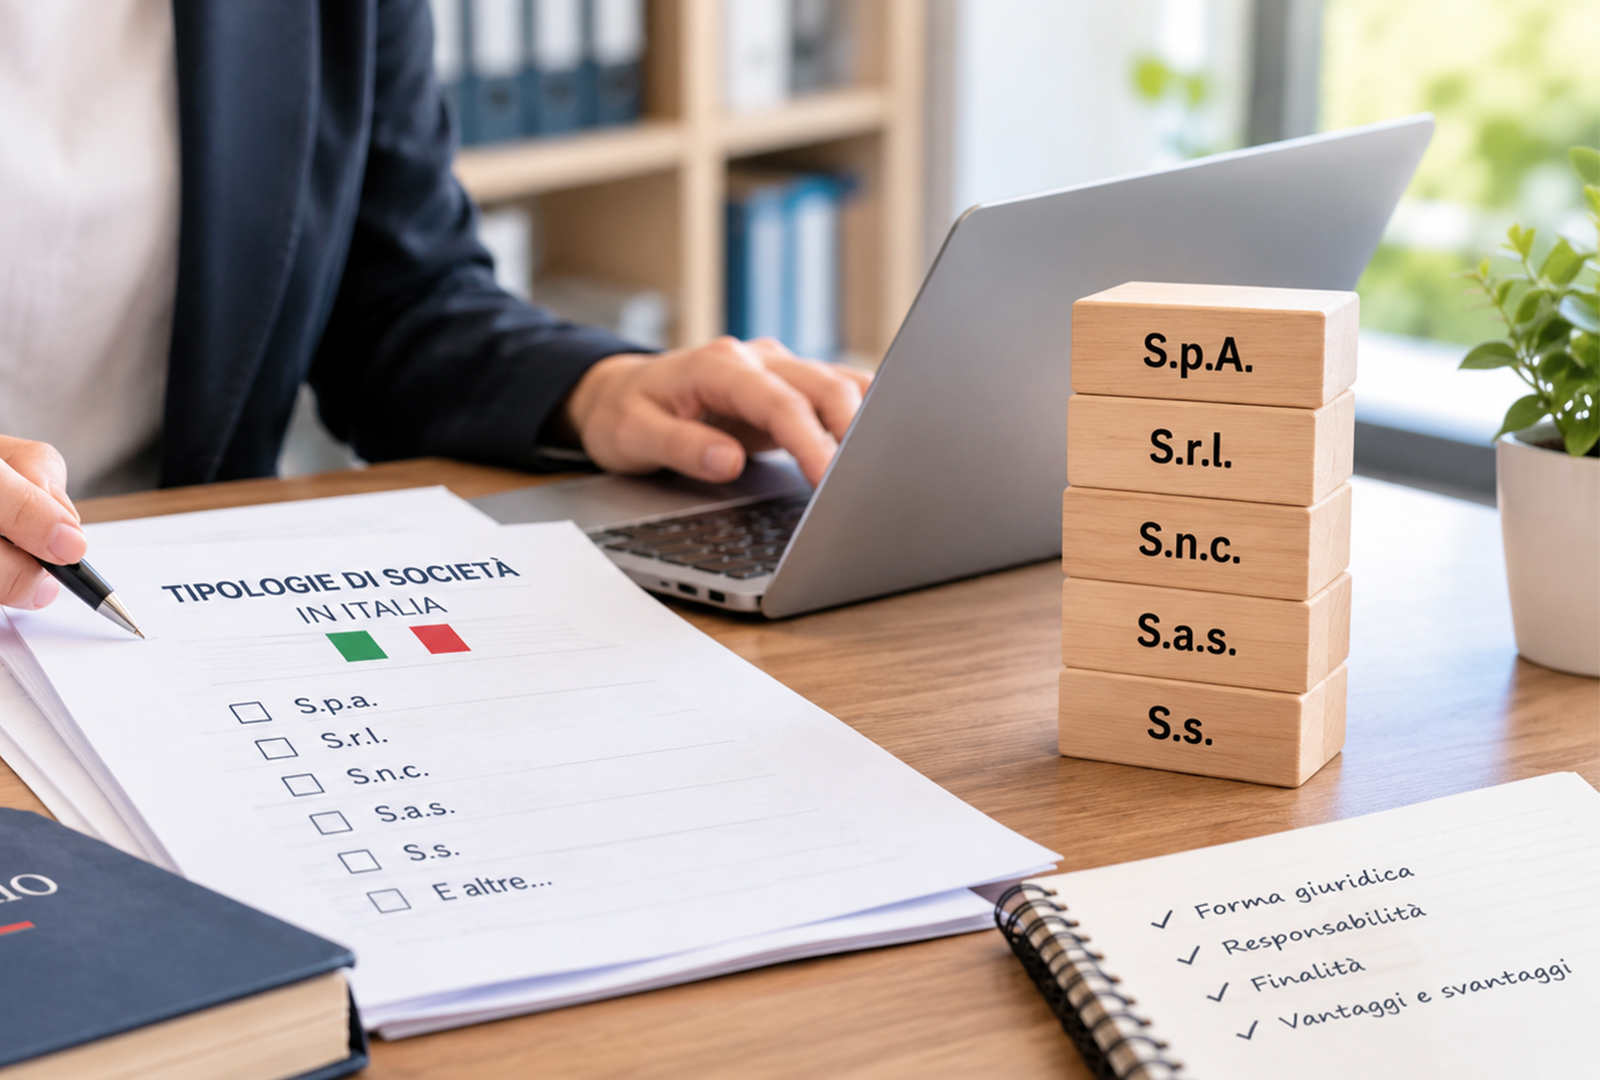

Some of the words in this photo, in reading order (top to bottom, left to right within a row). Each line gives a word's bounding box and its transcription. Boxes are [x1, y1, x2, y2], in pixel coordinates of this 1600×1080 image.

[1143, 332, 1253, 379] S.p.A.
[1149, 428, 1232, 469] S.r.l.
[1138, 521, 1241, 565] S.n.c.
[162, 573, 341, 603] TIPOLOGIE
[341, 570, 380, 590] DI
[382, 557, 521, 586] SOCIETÀ
[296, 604, 337, 624] IN
[340, 596, 448, 620] ITALIA
[1137, 612, 1237, 657] S.a.s.
[294, 695, 378, 716] S.p.a.
[1147, 705, 1213, 746] S.s.
[320, 726, 388, 749] S.r.l.
[346, 765, 429, 785] S.n.c.
[374, 802, 456, 823] S.a.s.
[403, 843, 460, 862] S.s.
[431, 882, 458, 902] E
[462, 876, 552, 897] altre...
[1194, 892, 1286, 920] Forma
[1295, 867, 1415, 904] giuridica
[1221, 903, 1427, 955] Responsabilità
[1250, 957, 1366, 992] Finalità
[1278, 991, 1408, 1029] Vantaggi
[1417, 991, 1432, 1003] e
[1441, 958, 1572, 999] svantaggi
